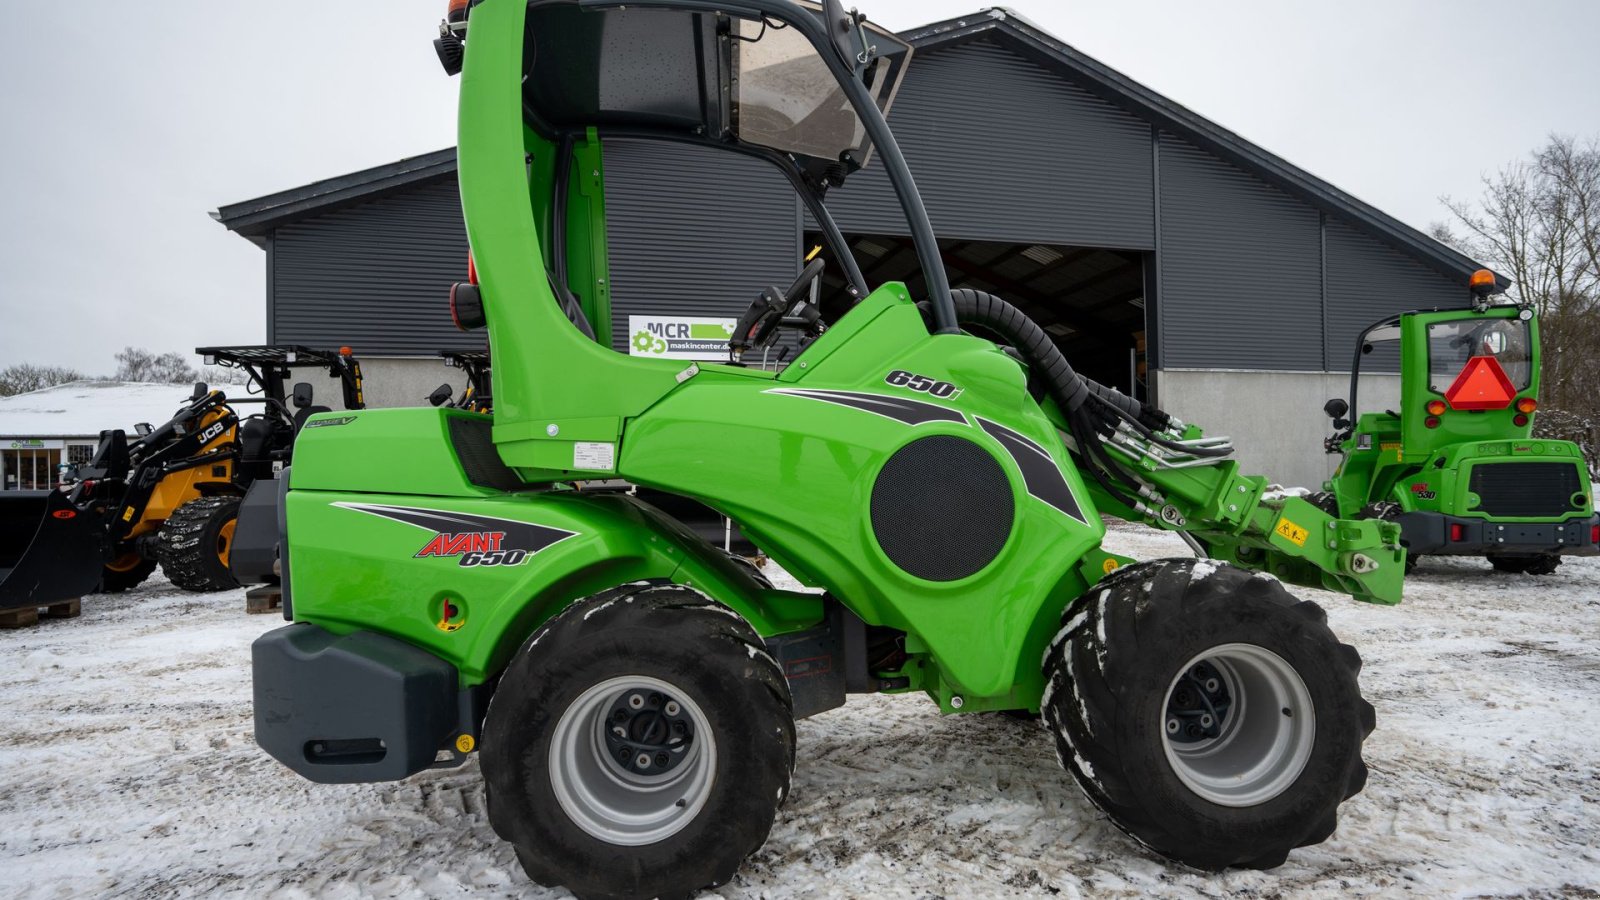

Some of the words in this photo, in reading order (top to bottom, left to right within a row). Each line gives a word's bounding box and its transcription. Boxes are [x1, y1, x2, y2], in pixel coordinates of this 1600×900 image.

[647, 322, 690, 338] MCR
[200, 421, 224, 444] JCB
[413, 532, 506, 557] AVANT
